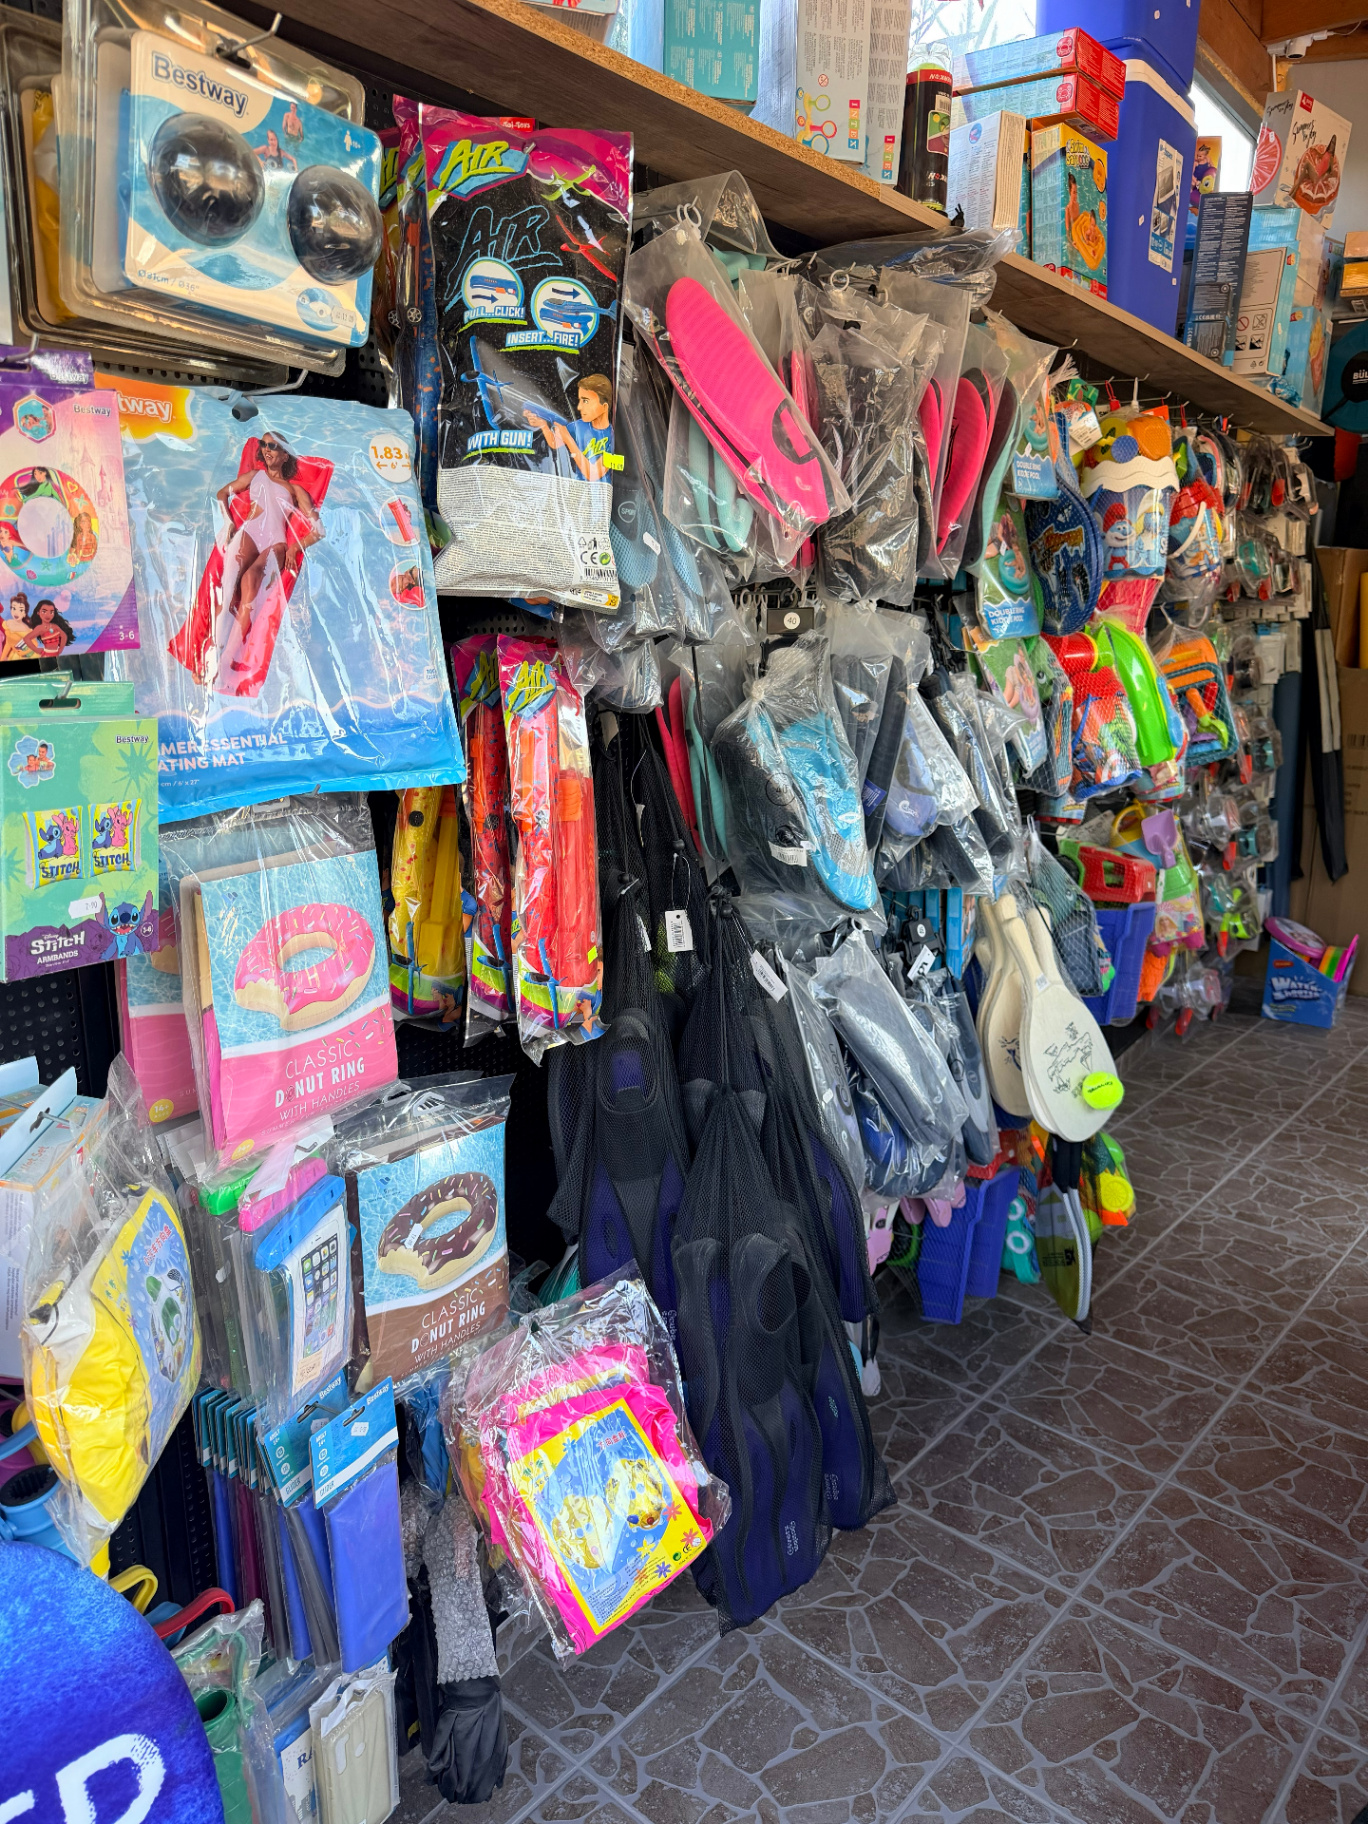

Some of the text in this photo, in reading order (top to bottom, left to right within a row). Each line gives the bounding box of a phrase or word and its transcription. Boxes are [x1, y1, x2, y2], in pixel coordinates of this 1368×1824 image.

[151, 51, 249, 119] Bestway
[848, 99, 861, 150] INTEX
[438, 139, 515, 191] AIR
[881, 135, 895, 180] INTEX
[464, 305, 526, 322] PULL...CLICK!
[505, 330, 581, 347] INSERT...FIRE!
[74, 404, 111, 417] Bestway
[467, 431, 534, 449] WITH GUN!
[371, 445, 403, 460] 1.83
[116, 735, 149, 744] Bestway
[203, 732, 288, 752] ESSENTIAL
[212, 752, 246, 768] MAT
[41, 861, 80, 879] STITCH
[94, 852, 129, 868] STITCH
[36, 950, 79, 965] ARMBANDS
[285, 1039, 354, 1079] CLASSIC
[275, 1057, 365, 1108] DONUT RING
[279, 1081, 360, 1121] WITH HANDLES
[421, 1288, 478, 1329] CLASSIC
[411, 1301, 485, 1354] DONUT RING
[414, 1321, 481, 1363] WITH HANDLES
[319, 1376, 341, 1400] Bestway
